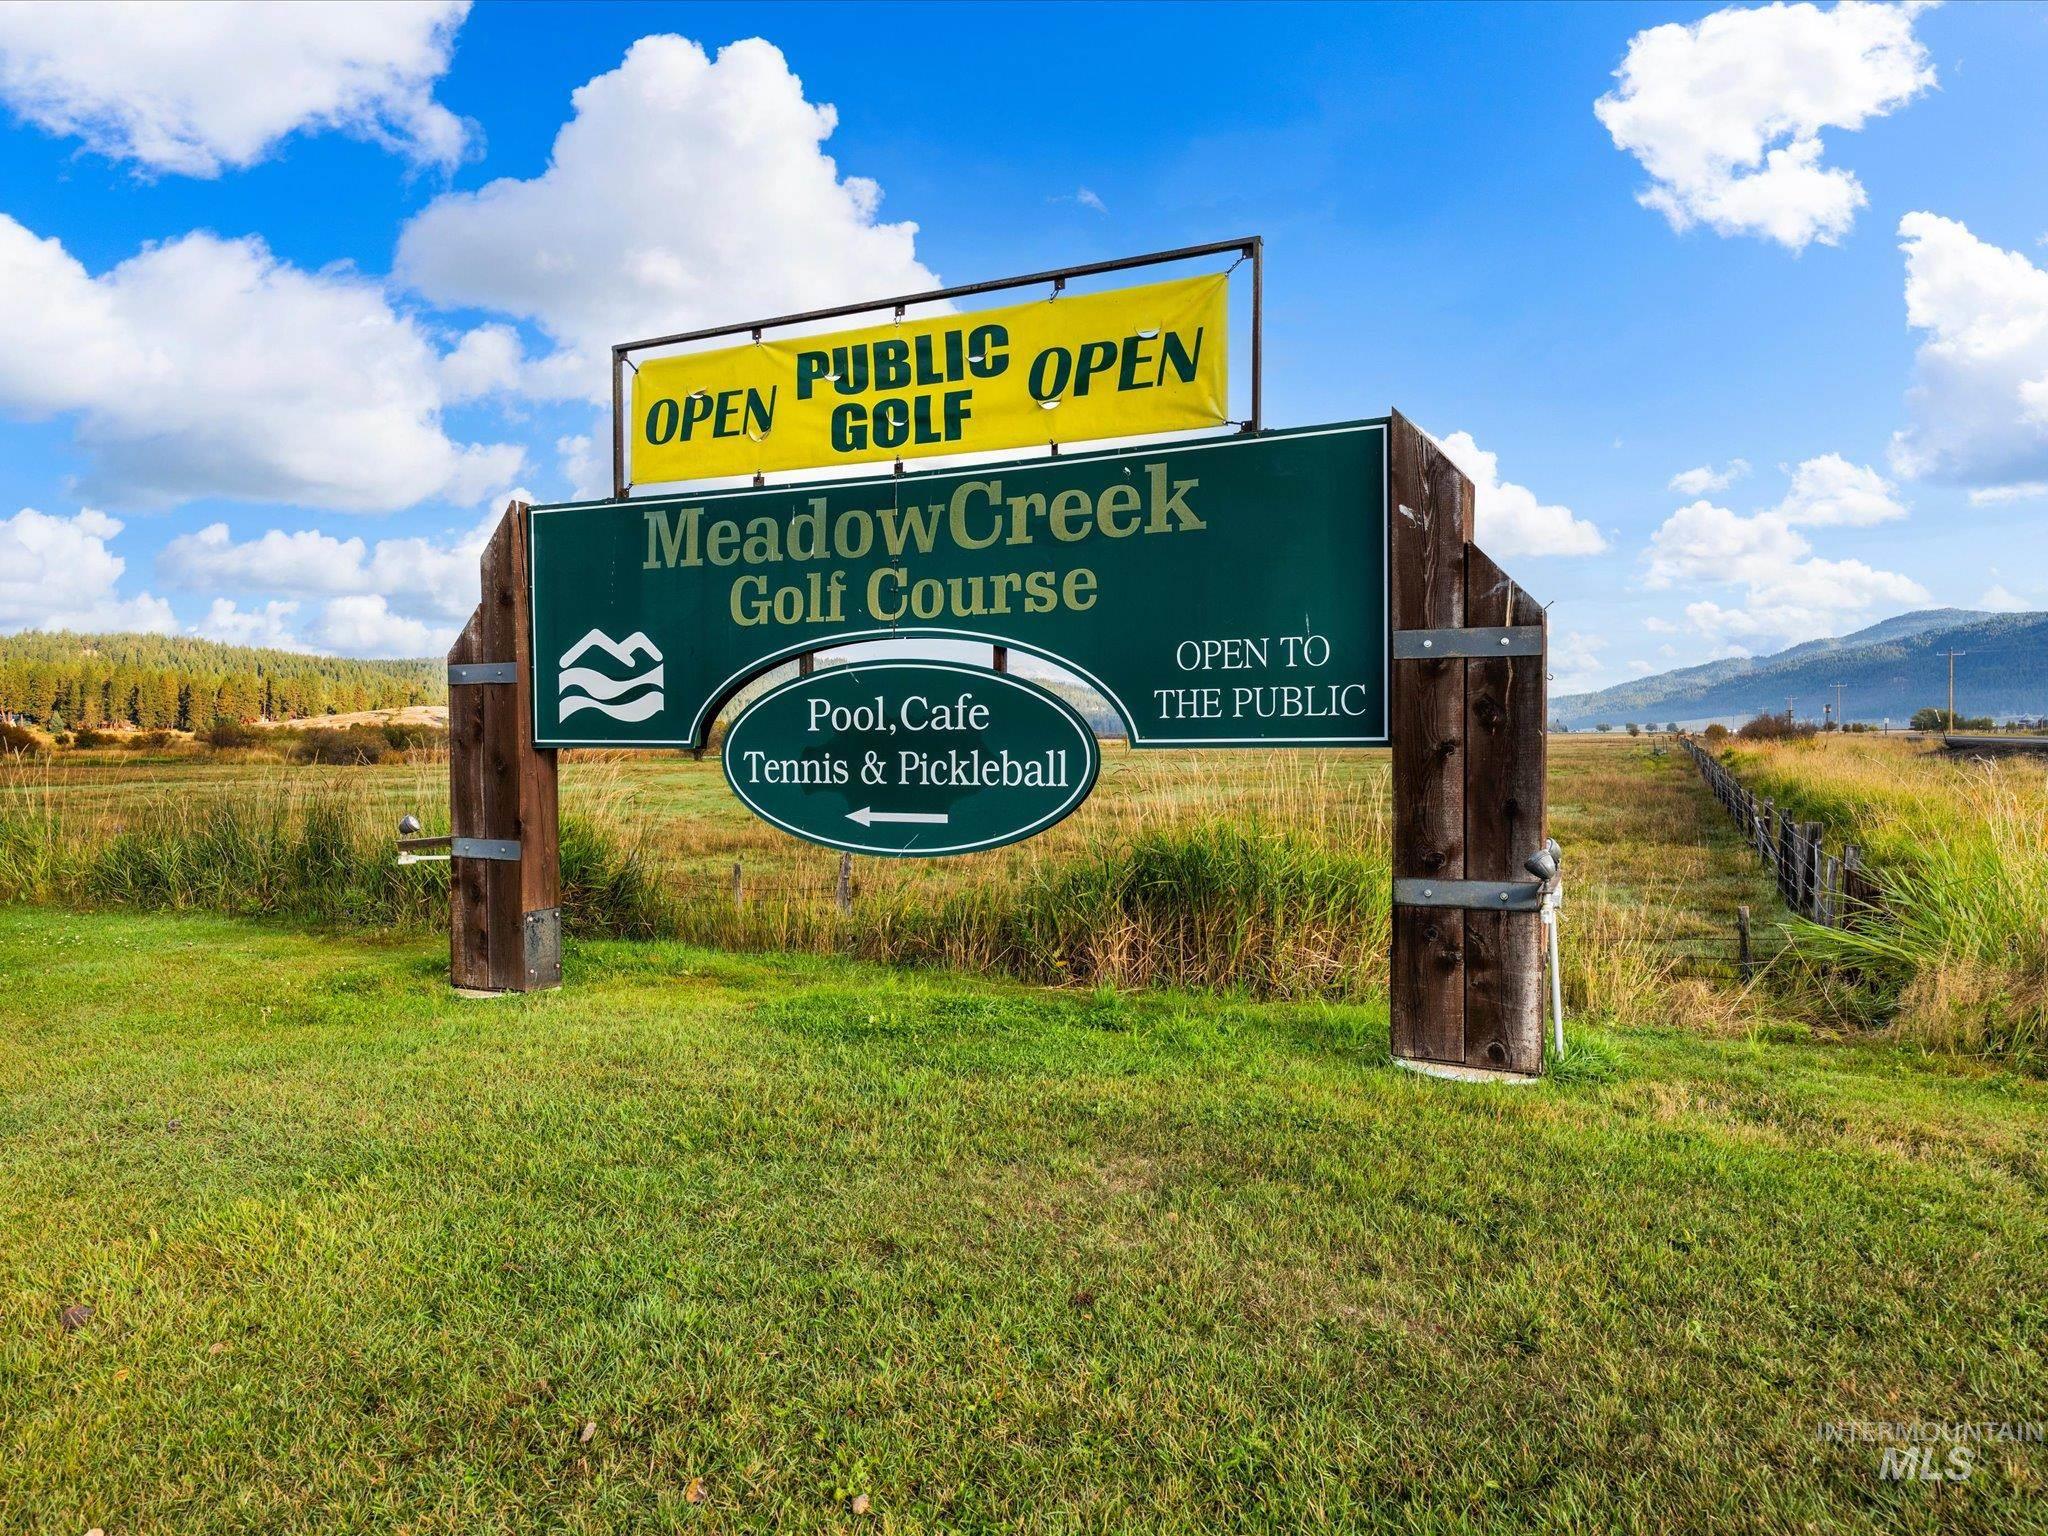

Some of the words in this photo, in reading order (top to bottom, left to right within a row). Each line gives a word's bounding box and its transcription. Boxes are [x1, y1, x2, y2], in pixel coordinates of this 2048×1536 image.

[797, 324, 1010, 400] PUBLIC
[1028, 326, 1204, 403] OPEN
[645, 385, 777, 446] OPEN
[830, 389, 973, 453] GOLF
[643, 462, 1207, 570] MeadowCreek
[729, 569, 846, 627] Golf
[867, 566, 1098, 621] Course
[1176, 637, 1270, 671] OPEN
[1280, 635, 1330, 667] TO
[1154, 688, 1223, 719] THE
[1232, 684, 1366, 718] PUBLIC
[743, 750, 849, 785] Tennis
[860, 750, 887, 785] &
[898, 749, 1069, 788] Pickleball
